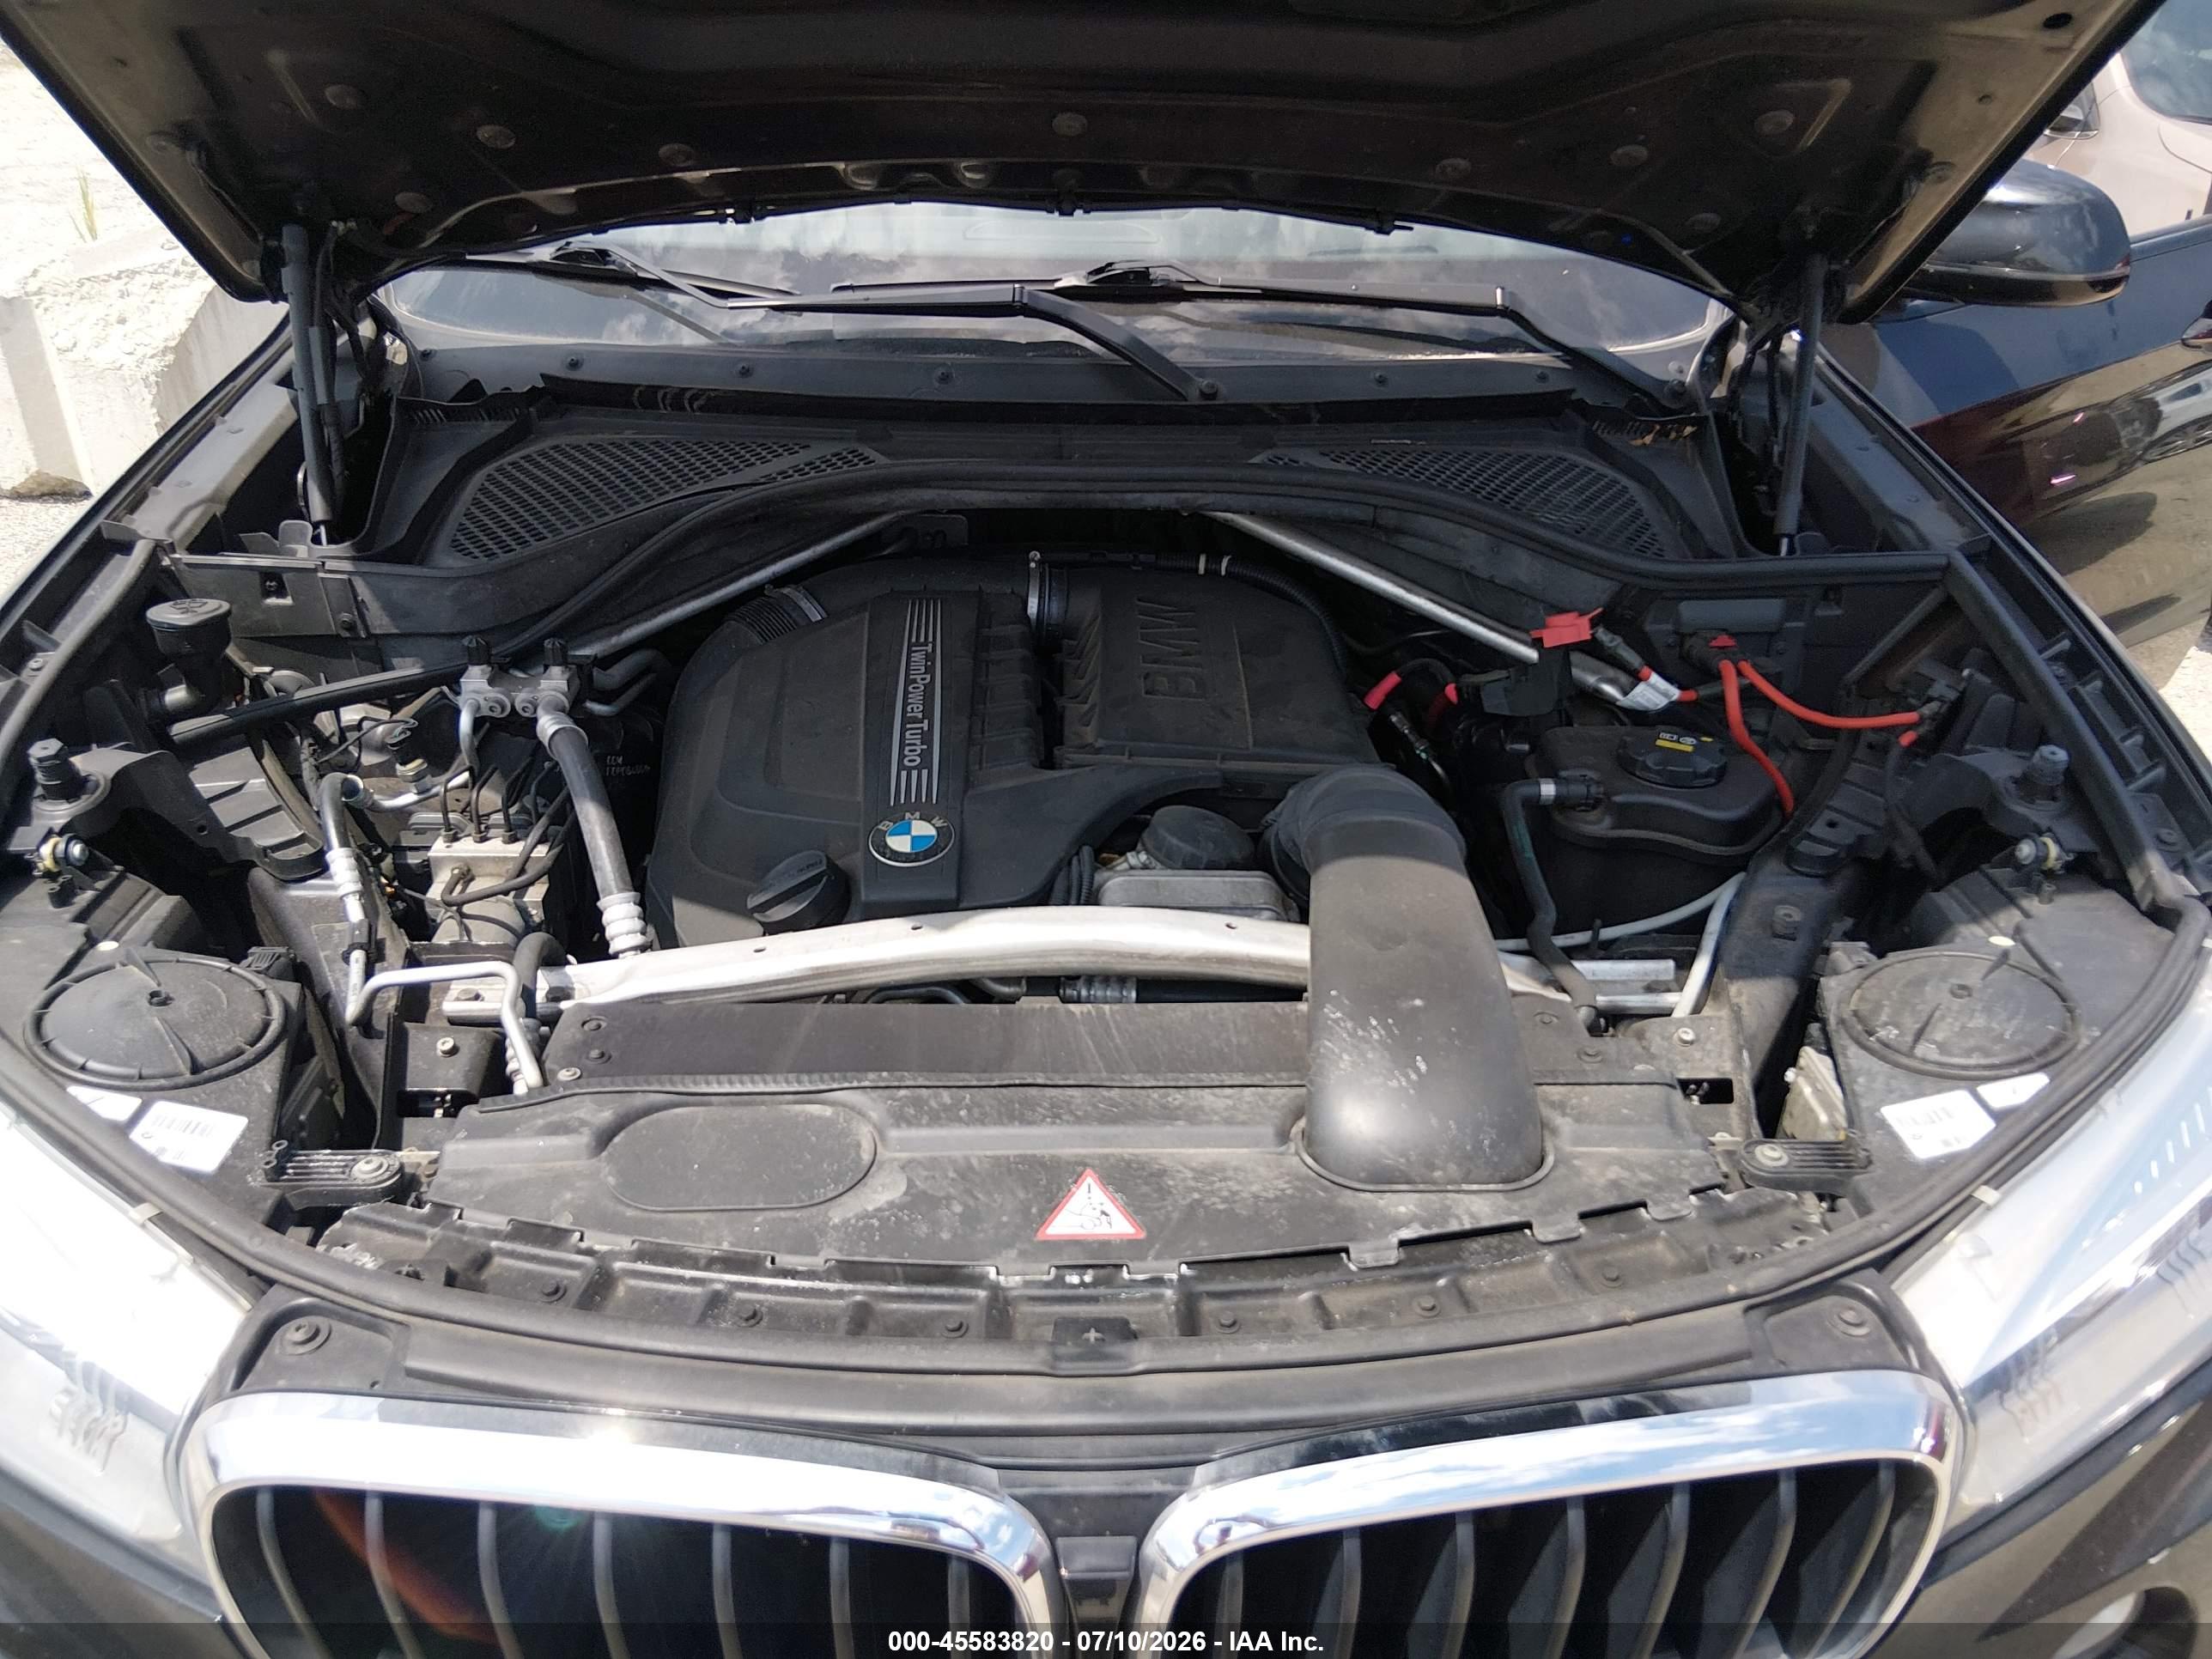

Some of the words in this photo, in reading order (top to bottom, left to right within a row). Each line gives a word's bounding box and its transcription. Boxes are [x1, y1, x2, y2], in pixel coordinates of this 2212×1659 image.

[906, 643, 933, 719] TwinPower
[1135, 599, 1205, 702] BMW
[902, 719, 929, 767] Turbo
[877, 811, 949, 831] BMW
